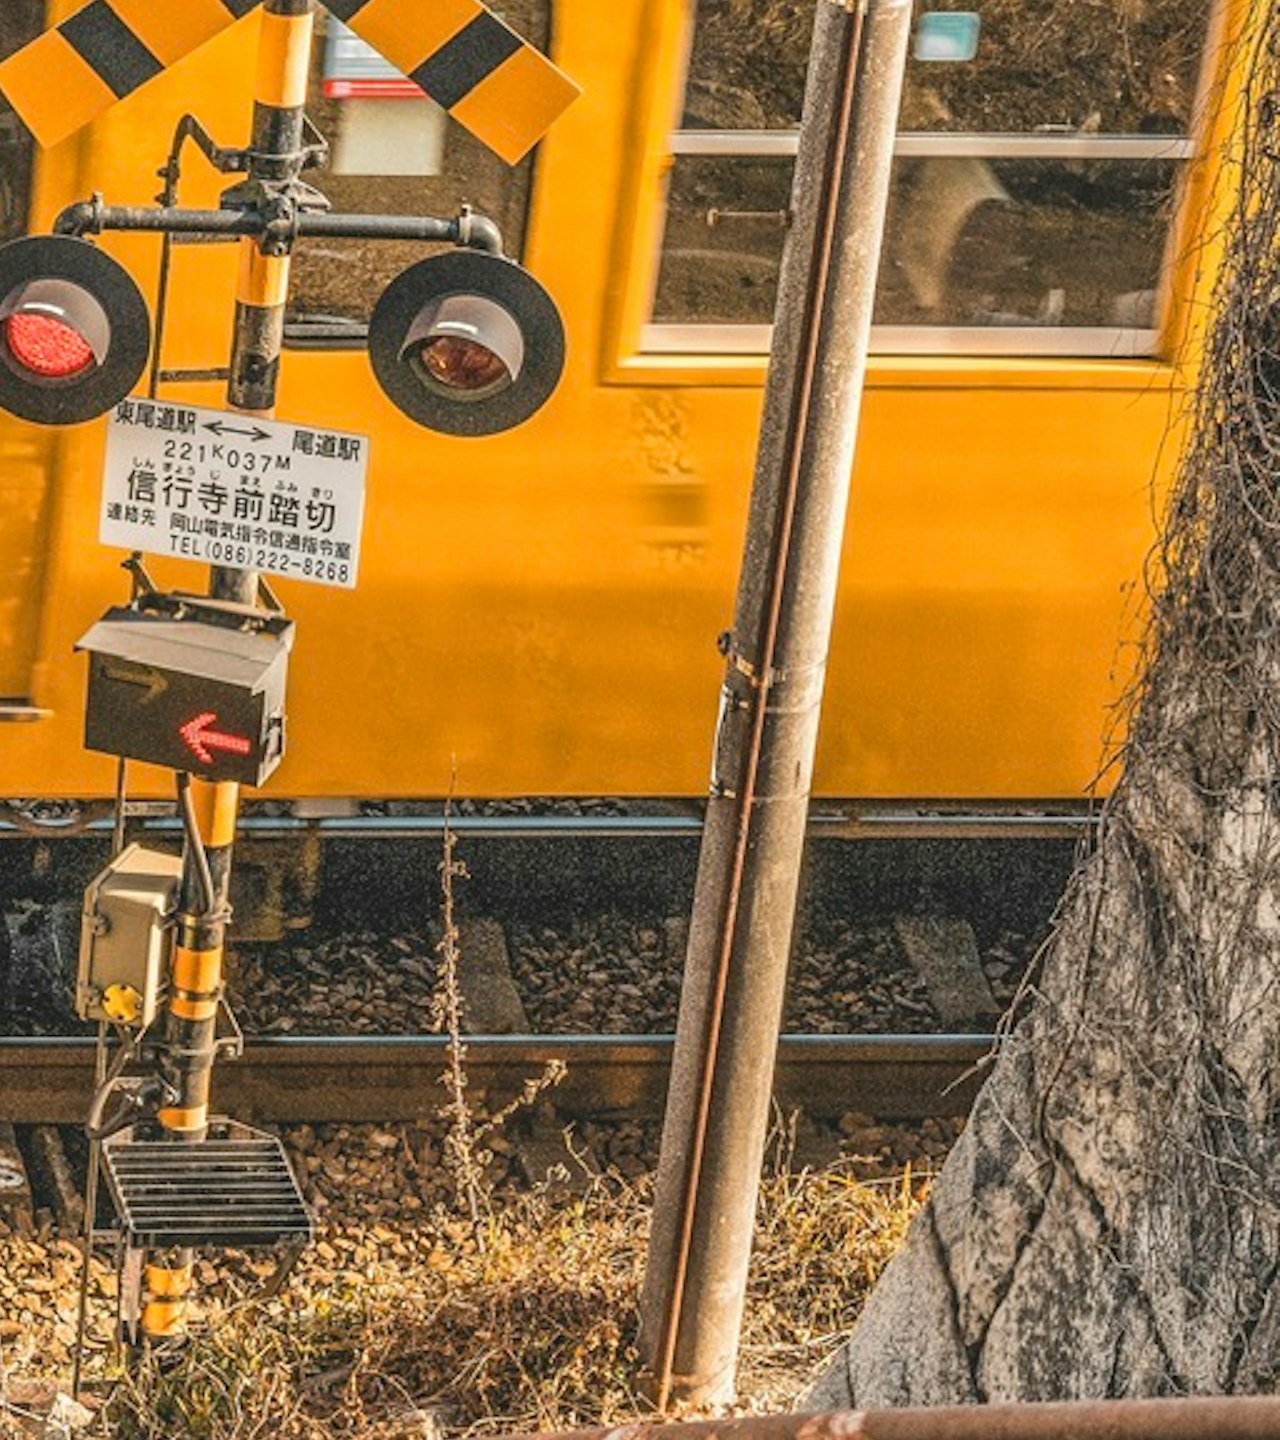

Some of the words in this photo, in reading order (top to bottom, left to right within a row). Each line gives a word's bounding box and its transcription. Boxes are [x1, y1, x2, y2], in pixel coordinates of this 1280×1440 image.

[114, 399, 197, 434] 東尾道駅
[292, 429, 361, 461] 尾道駅
[106, 502, 156, 526] 連絡先
[127, 469, 336, 534] 信行寺前踏切
